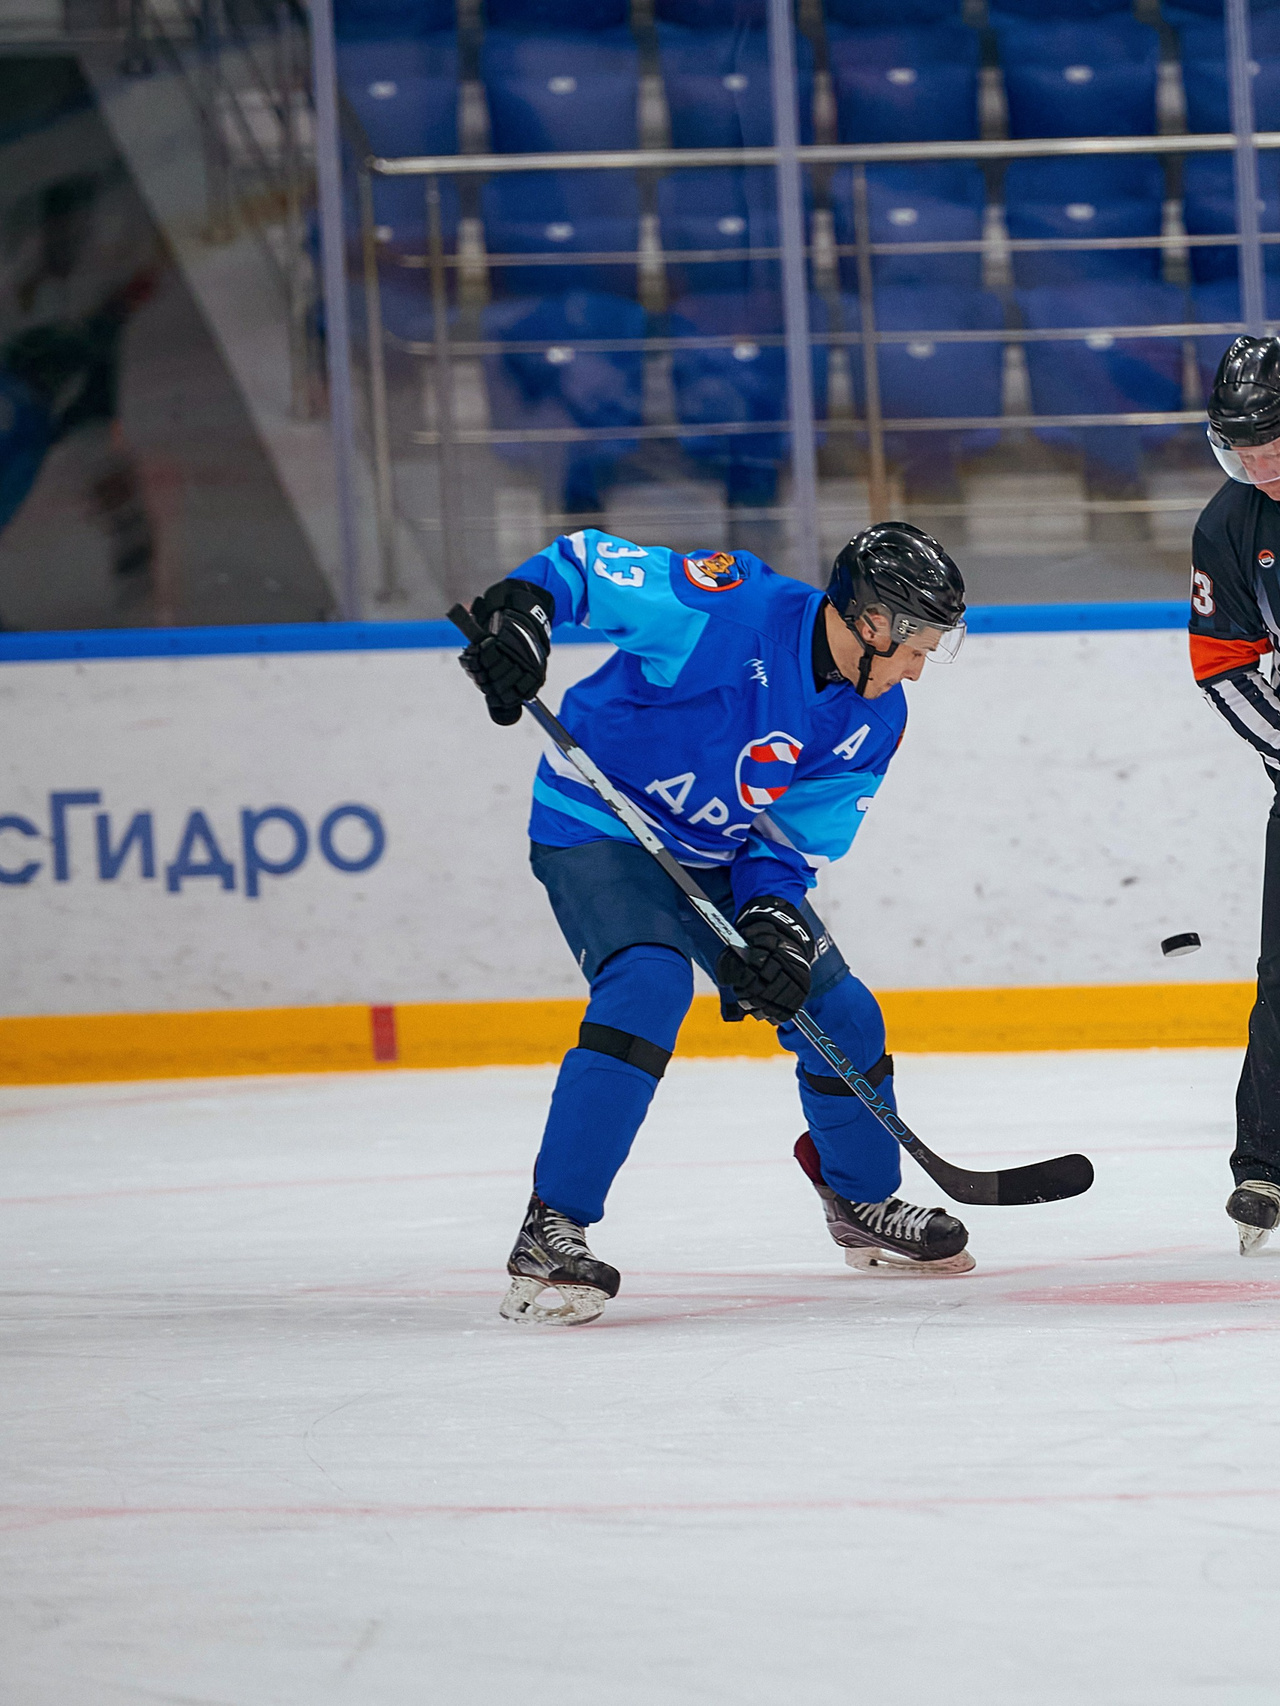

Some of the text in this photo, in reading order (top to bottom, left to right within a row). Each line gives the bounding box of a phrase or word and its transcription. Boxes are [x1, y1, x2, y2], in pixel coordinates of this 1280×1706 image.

[593, 541, 650, 589] 33
[1190, 564, 1217, 618] 3
[832, 723, 872, 761] A
[0, 789, 386, 898] сГидро
